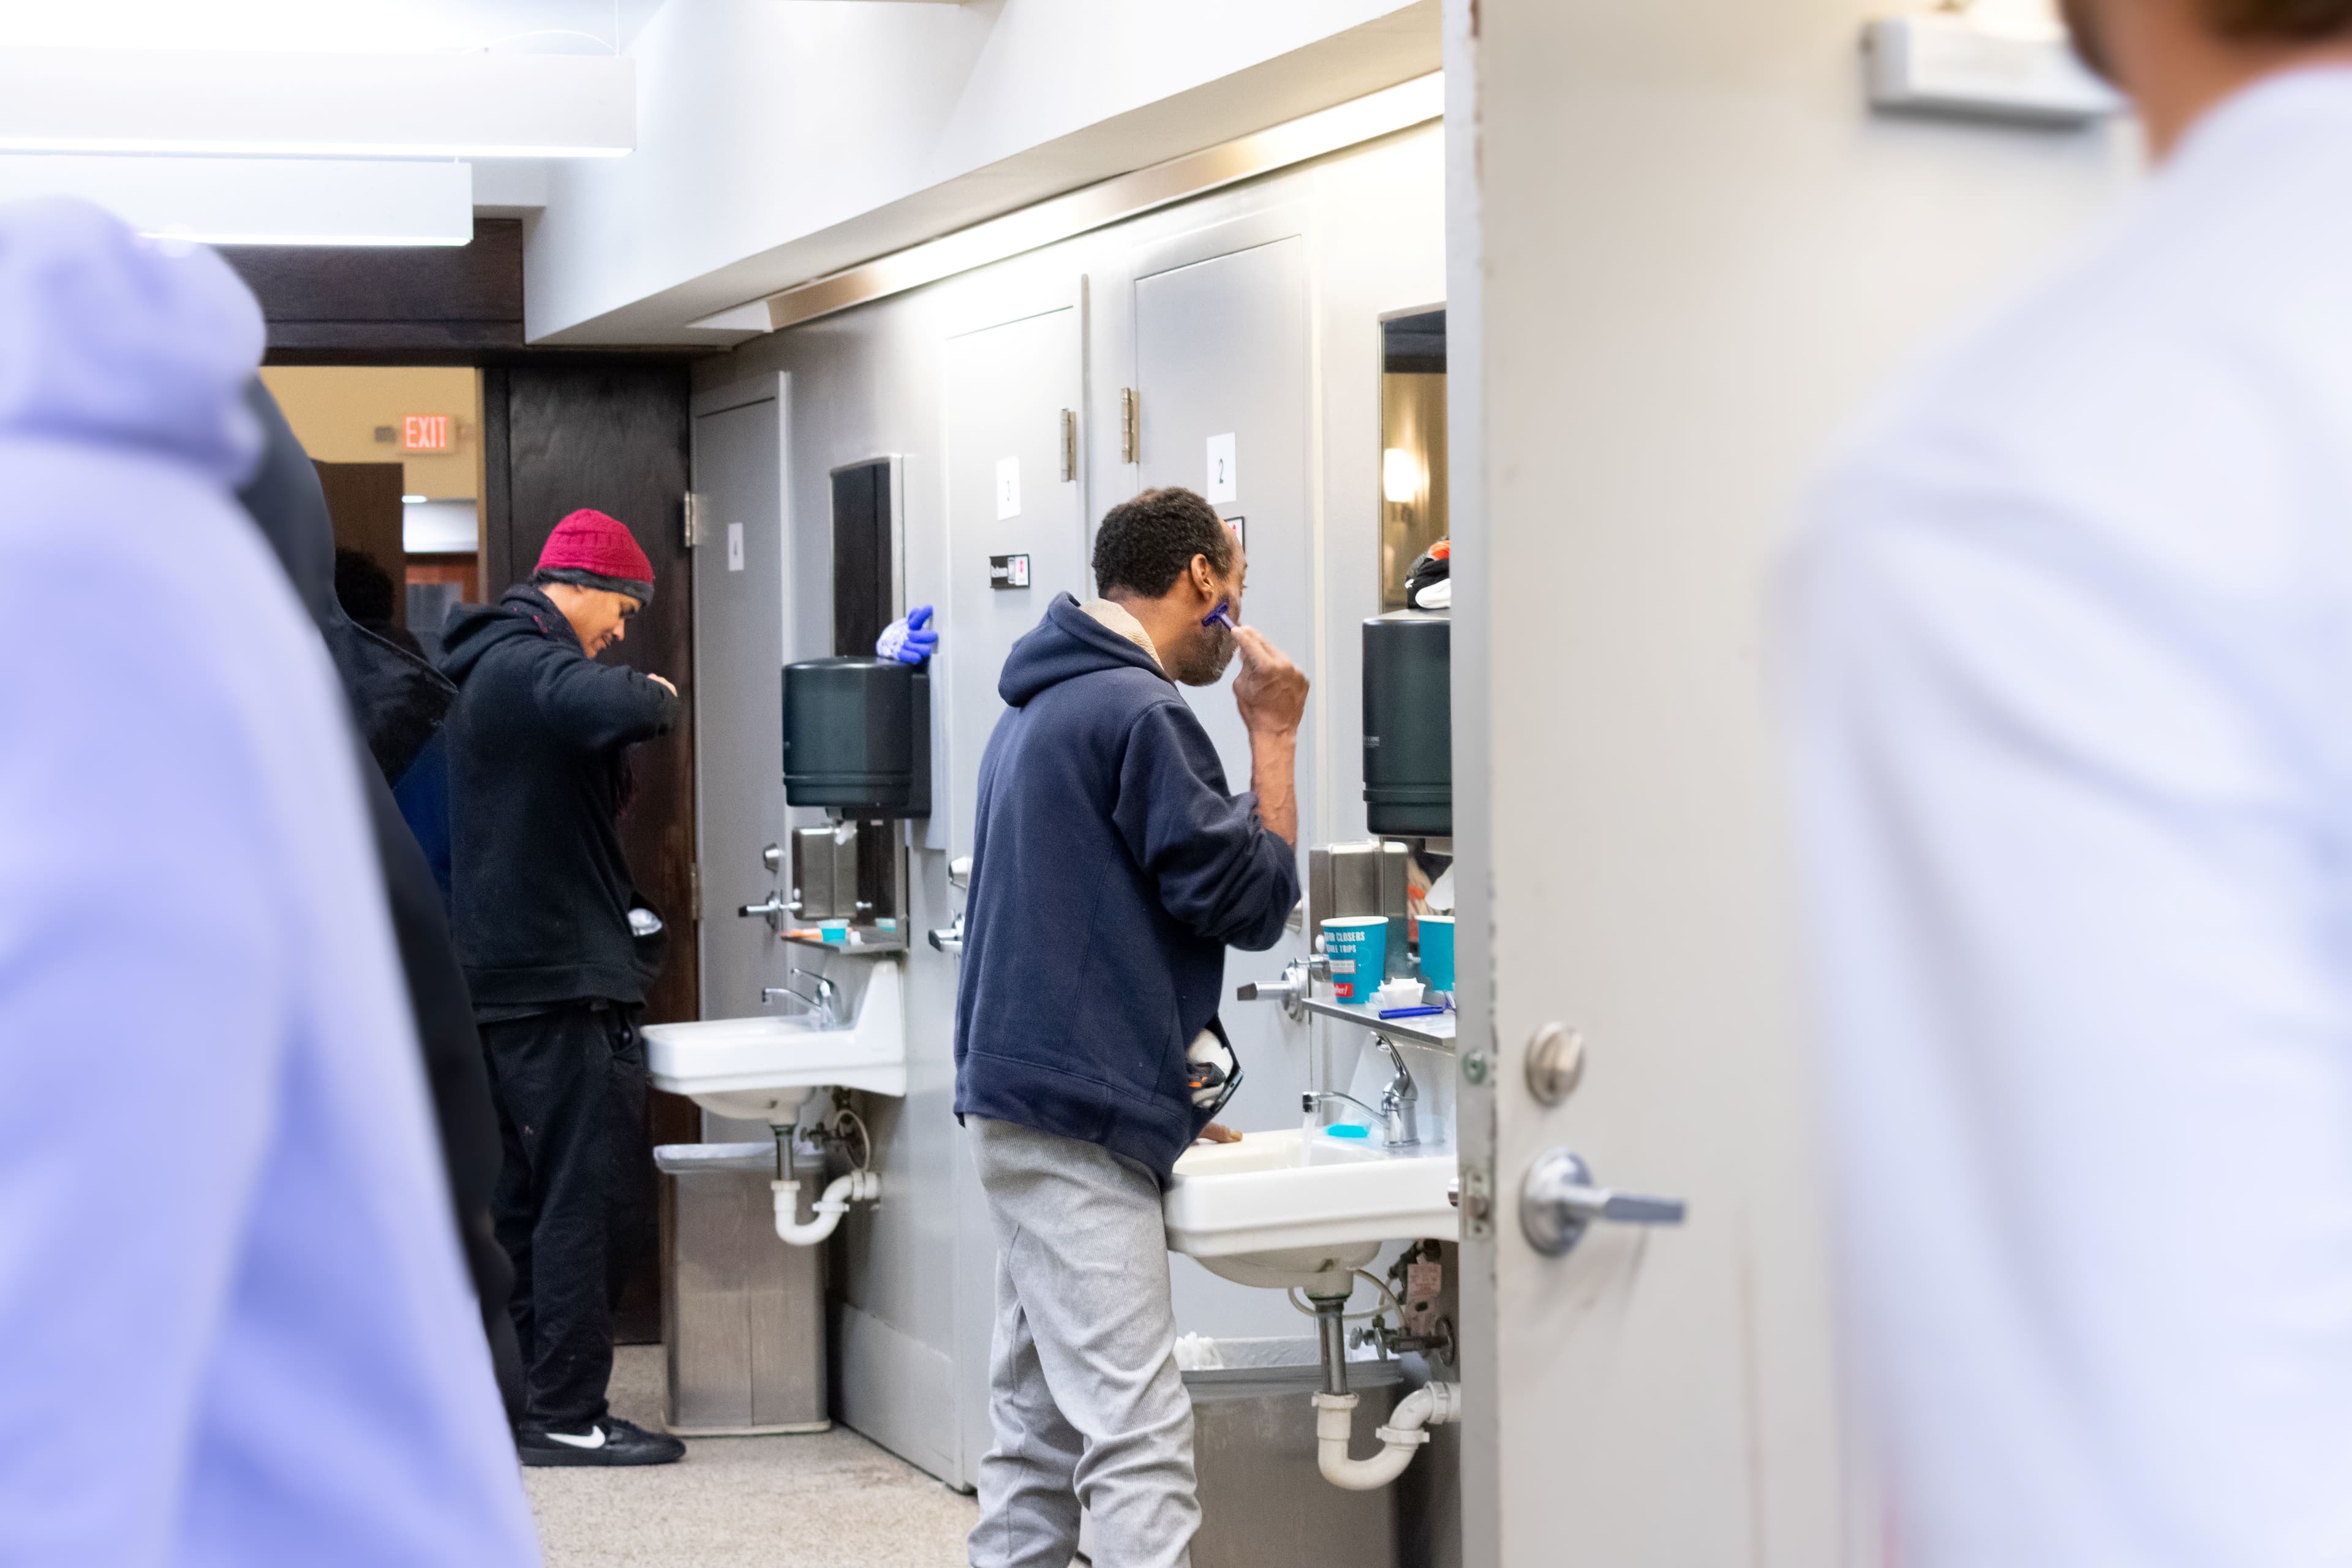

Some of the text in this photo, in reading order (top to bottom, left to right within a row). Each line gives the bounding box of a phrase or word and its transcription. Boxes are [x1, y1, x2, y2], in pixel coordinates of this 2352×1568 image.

[405, 416, 448, 448] EXIT
[1218, 458, 1224, 484] 2
[1336, 931, 1365, 941] CLOSERS
[1340, 944, 1357, 953] TRIPS
